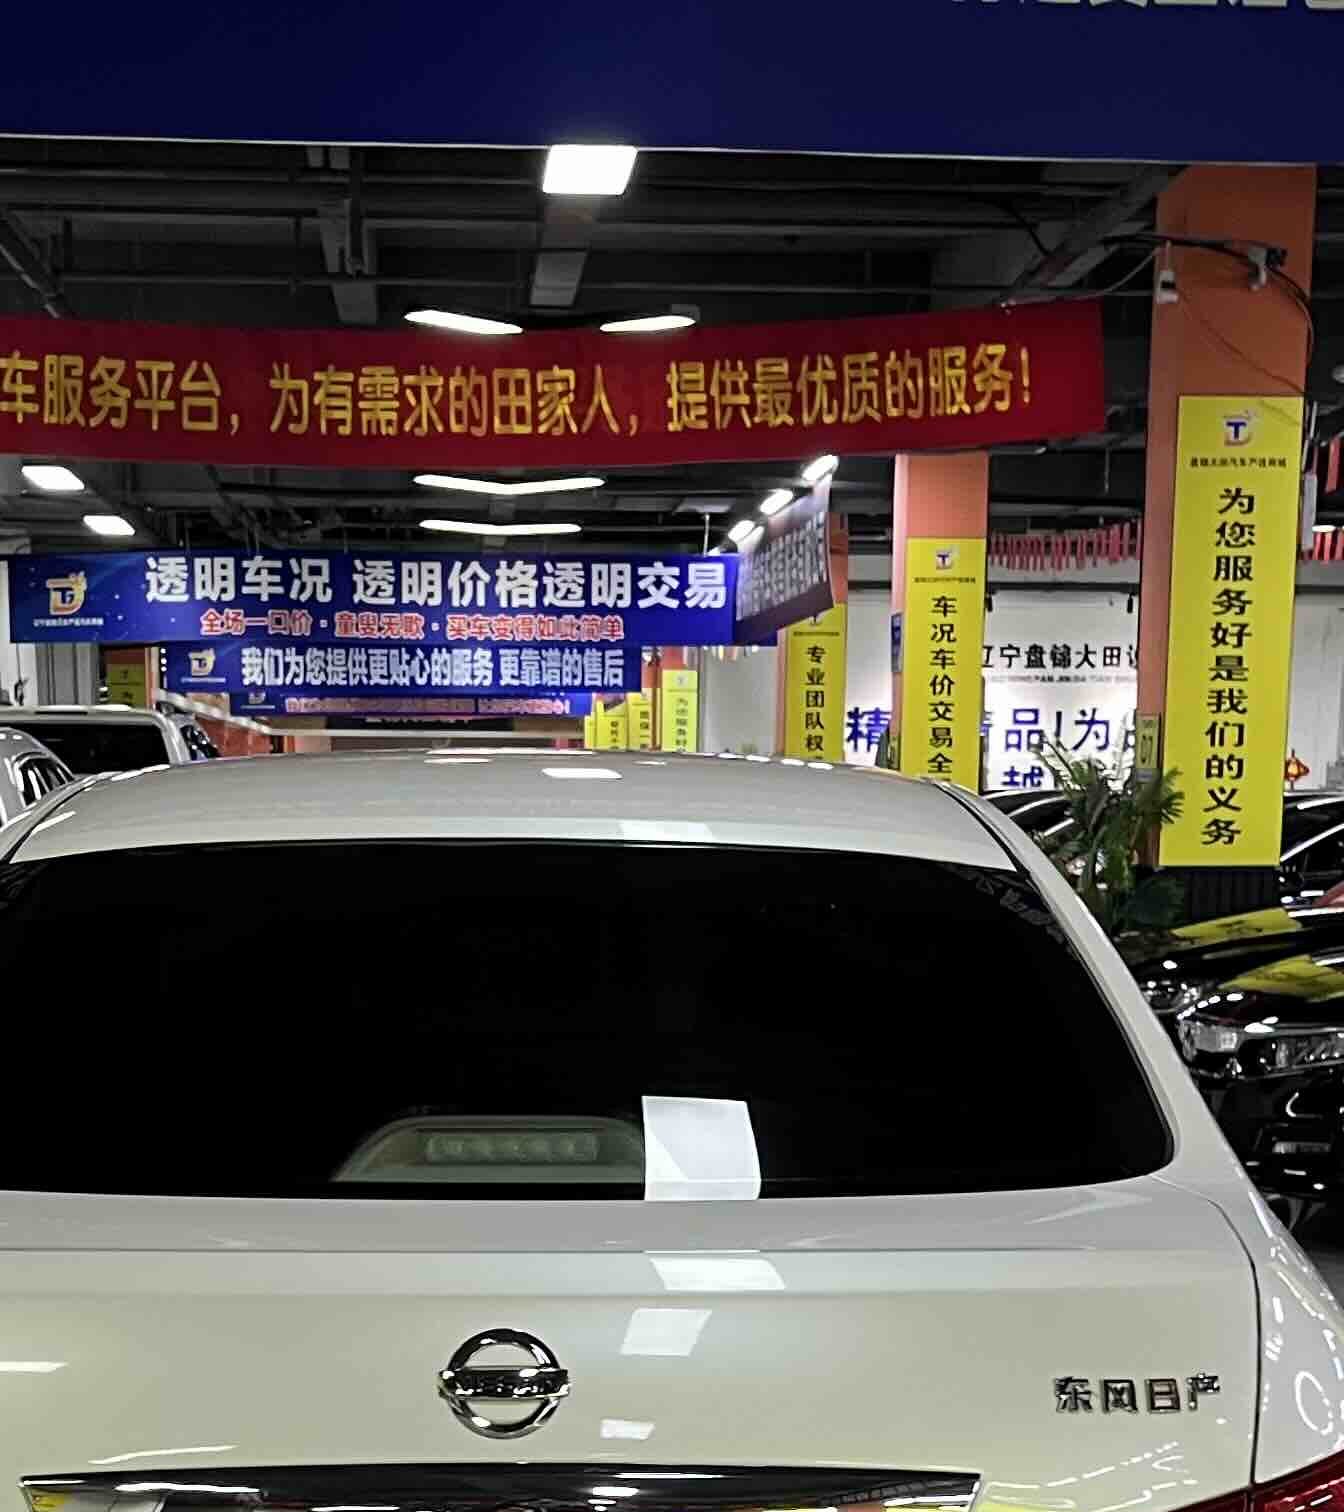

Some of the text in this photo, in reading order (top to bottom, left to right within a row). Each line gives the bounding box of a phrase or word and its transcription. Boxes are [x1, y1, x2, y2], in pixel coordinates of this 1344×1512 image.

[145, 556, 333, 603] 透明车况
[352, 560, 727, 609] 透明价格透明交易
[241, 647, 625, 686] 我们为您提供更贴心的服务 更靠谱的售后
[805, 646, 826, 759] 专业团队权
[928, 596, 958, 782] 车况车价交易全
[1202, 487, 1256, 846] 为您服务好是我们的义务
[1053, 1373, 1221, 1414] 东风日产
